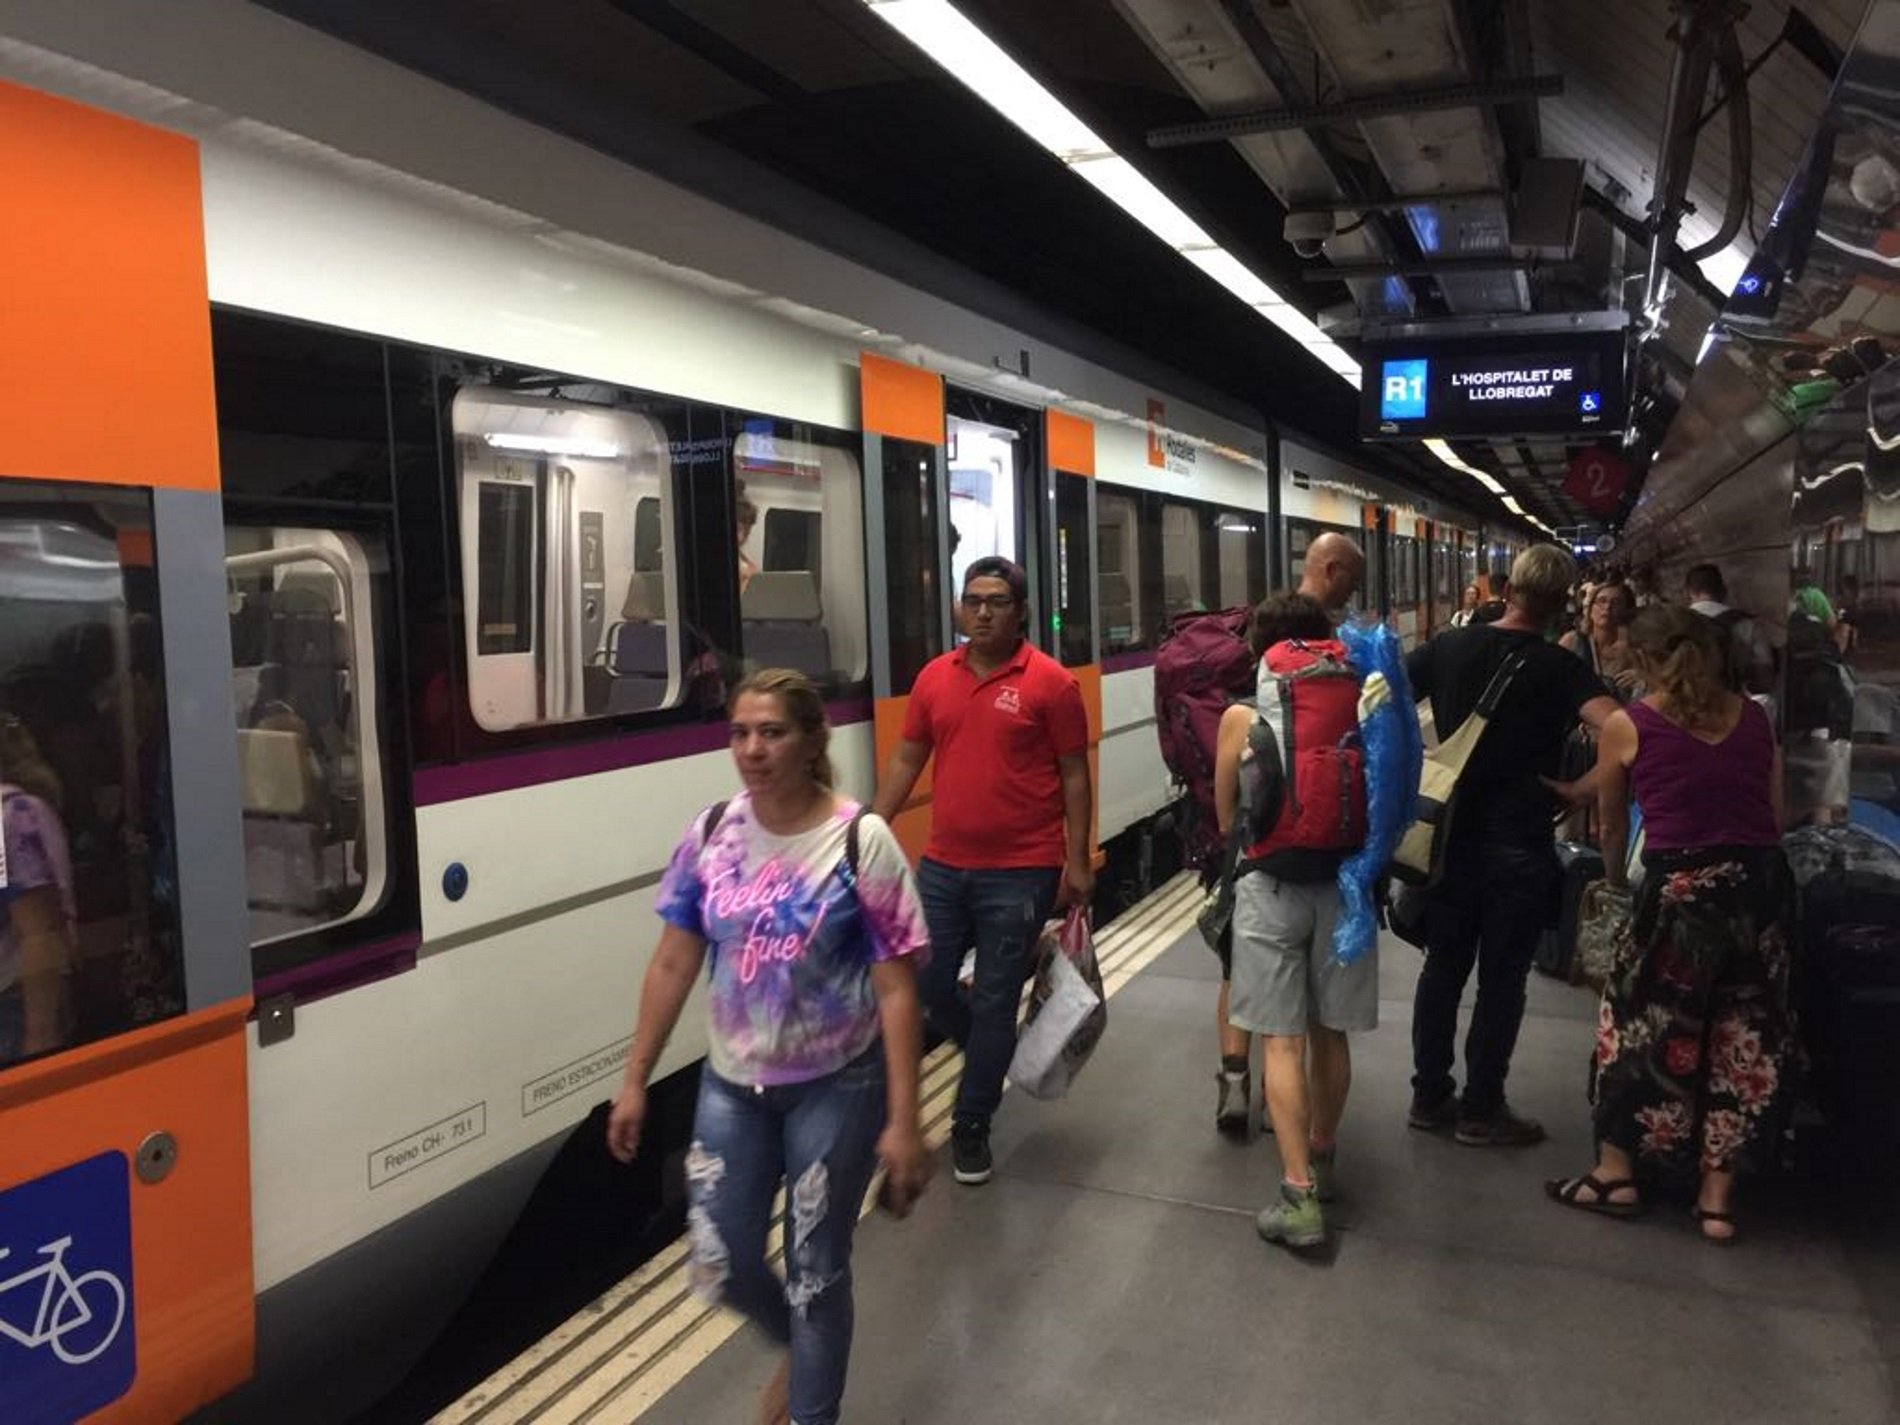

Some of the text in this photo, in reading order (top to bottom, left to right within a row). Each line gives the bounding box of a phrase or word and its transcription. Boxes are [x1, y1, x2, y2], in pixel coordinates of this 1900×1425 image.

[1385, 376, 1423, 402] R1
[1452, 368, 1573, 386] L'HOSPITALET DE
[1469, 385, 1554, 400] LLOBREGAT
[1587, 462, 1610, 497] 2
[532, 1076, 566, 1103] FRENO
[384, 1146, 418, 1171] Freno
